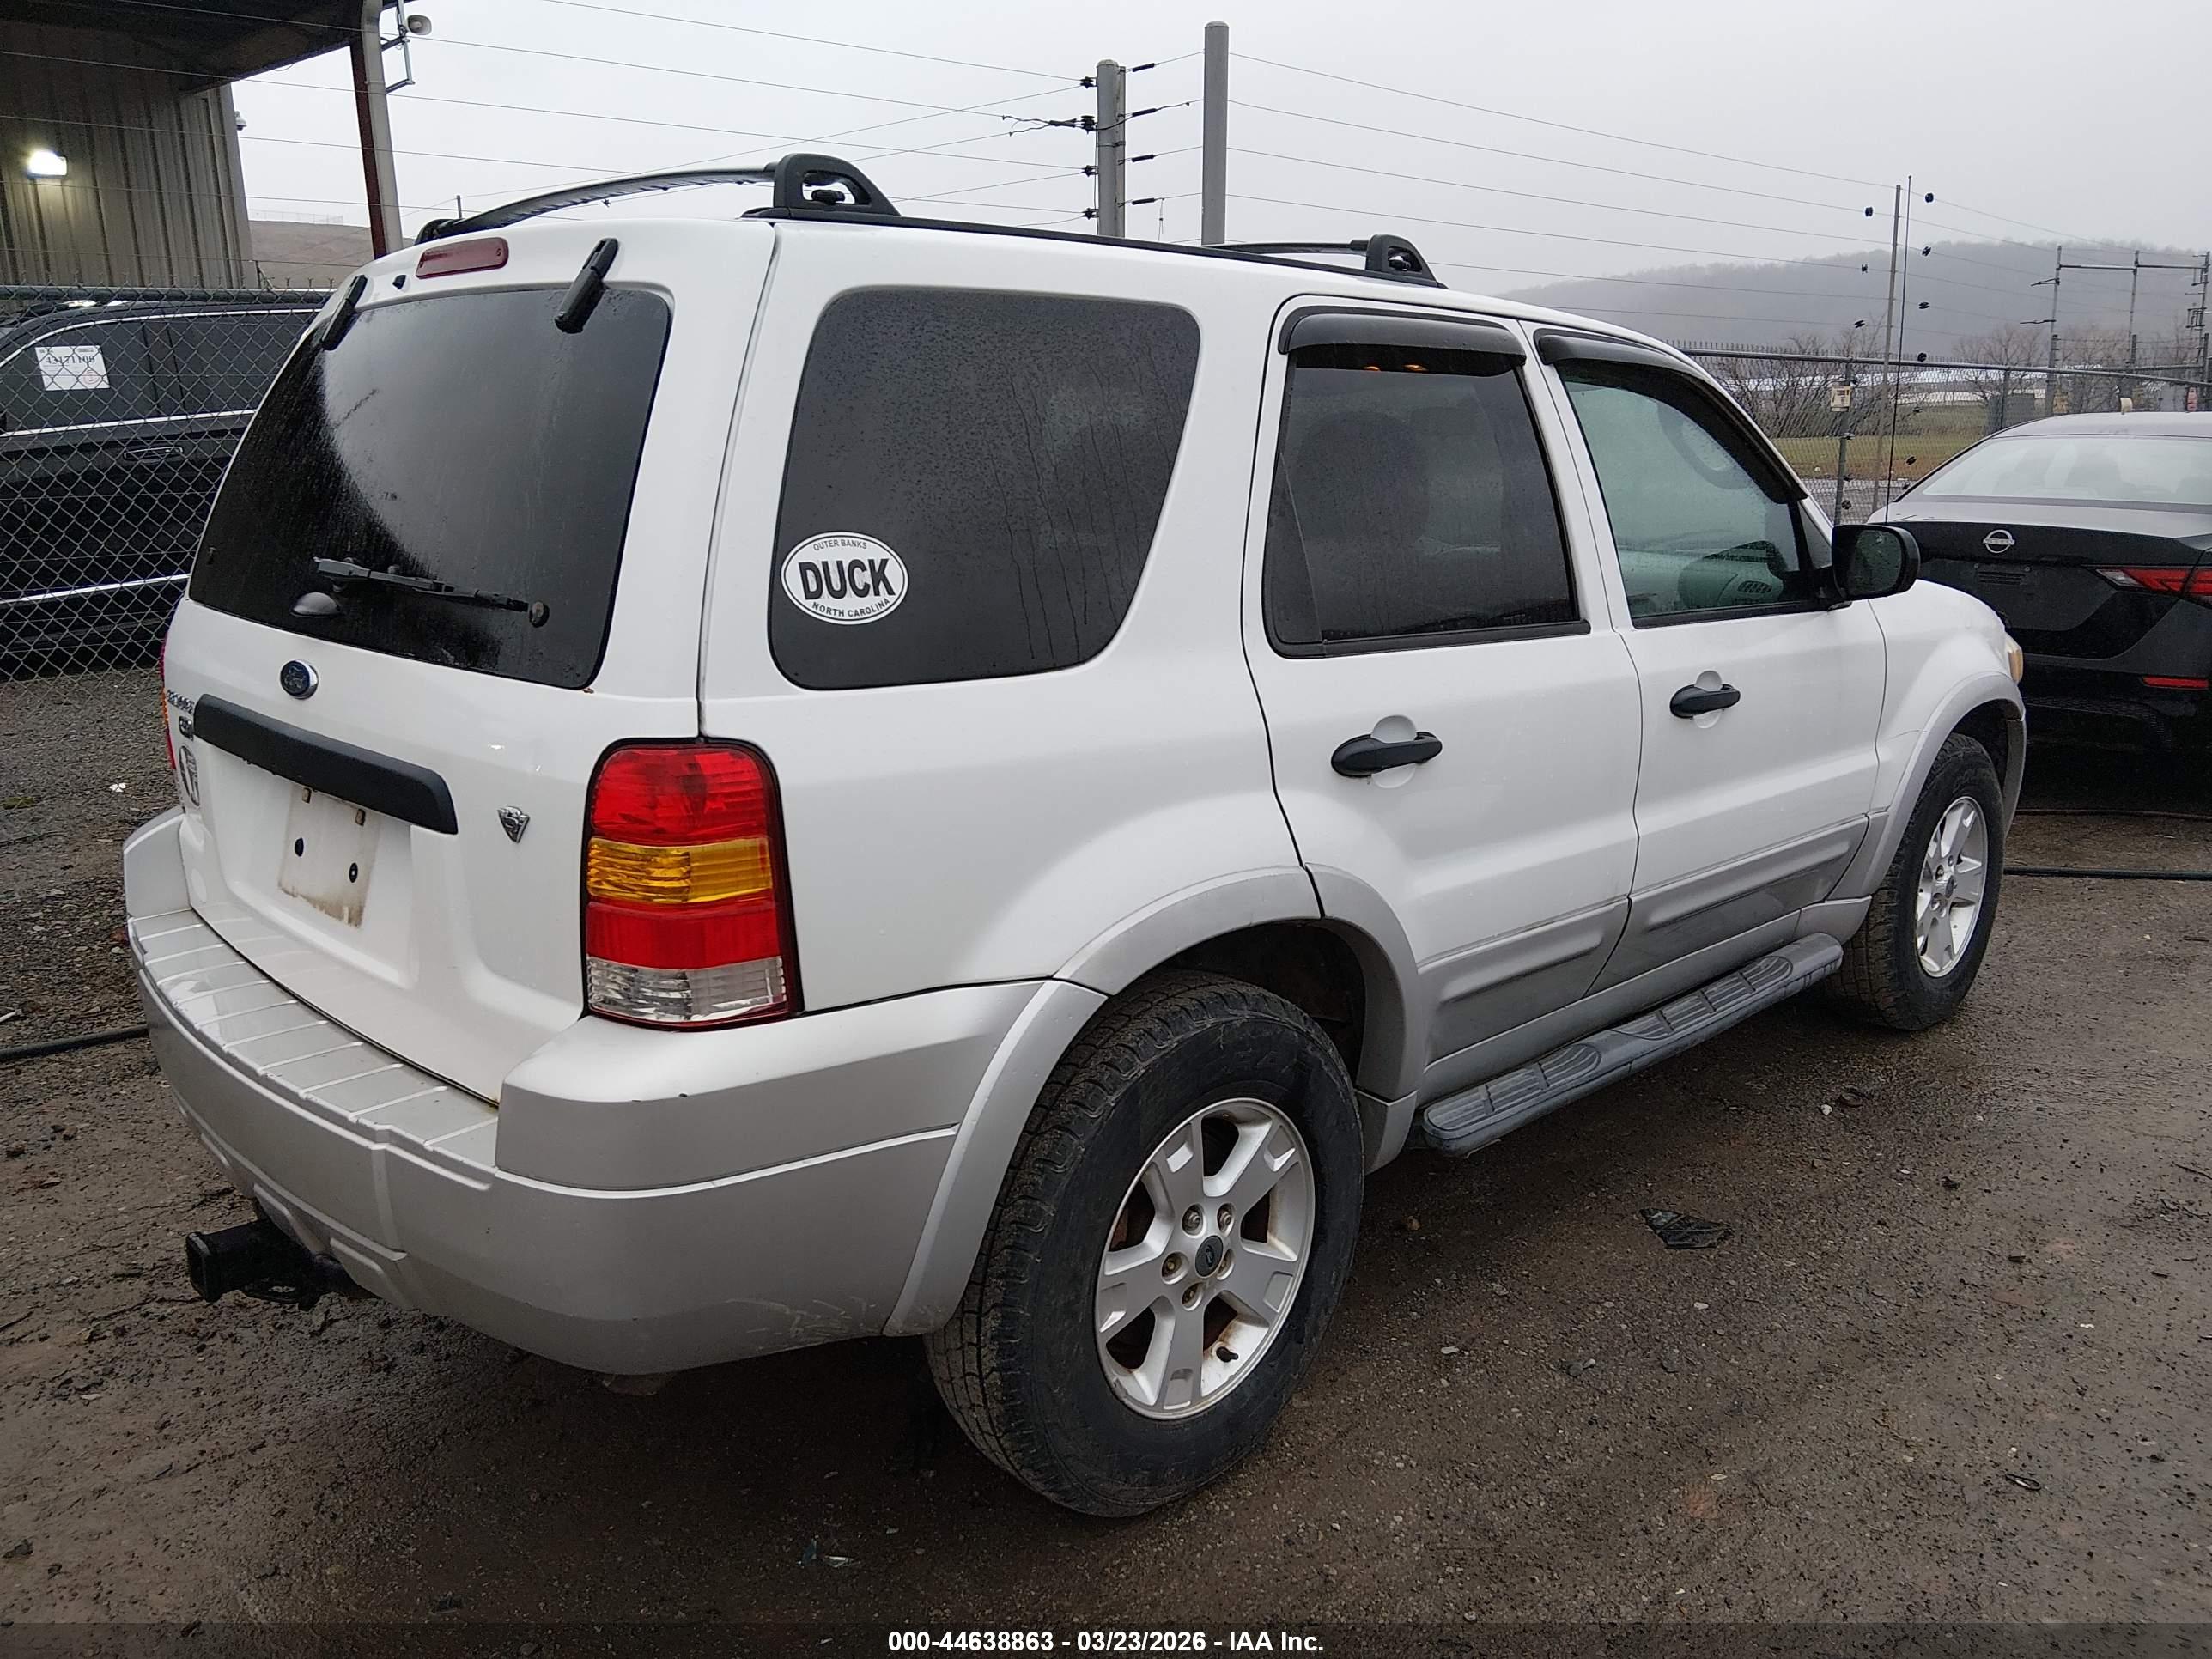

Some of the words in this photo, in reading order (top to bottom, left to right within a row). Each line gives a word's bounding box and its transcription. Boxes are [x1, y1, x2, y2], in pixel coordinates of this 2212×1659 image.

[813, 539, 840, 550] OUTER
[841, 539, 867, 550] BANKS
[799, 558, 896, 600] DUCK
[811, 601, 845, 617] NORTH
[848, 598, 890, 617] CAROLINA
